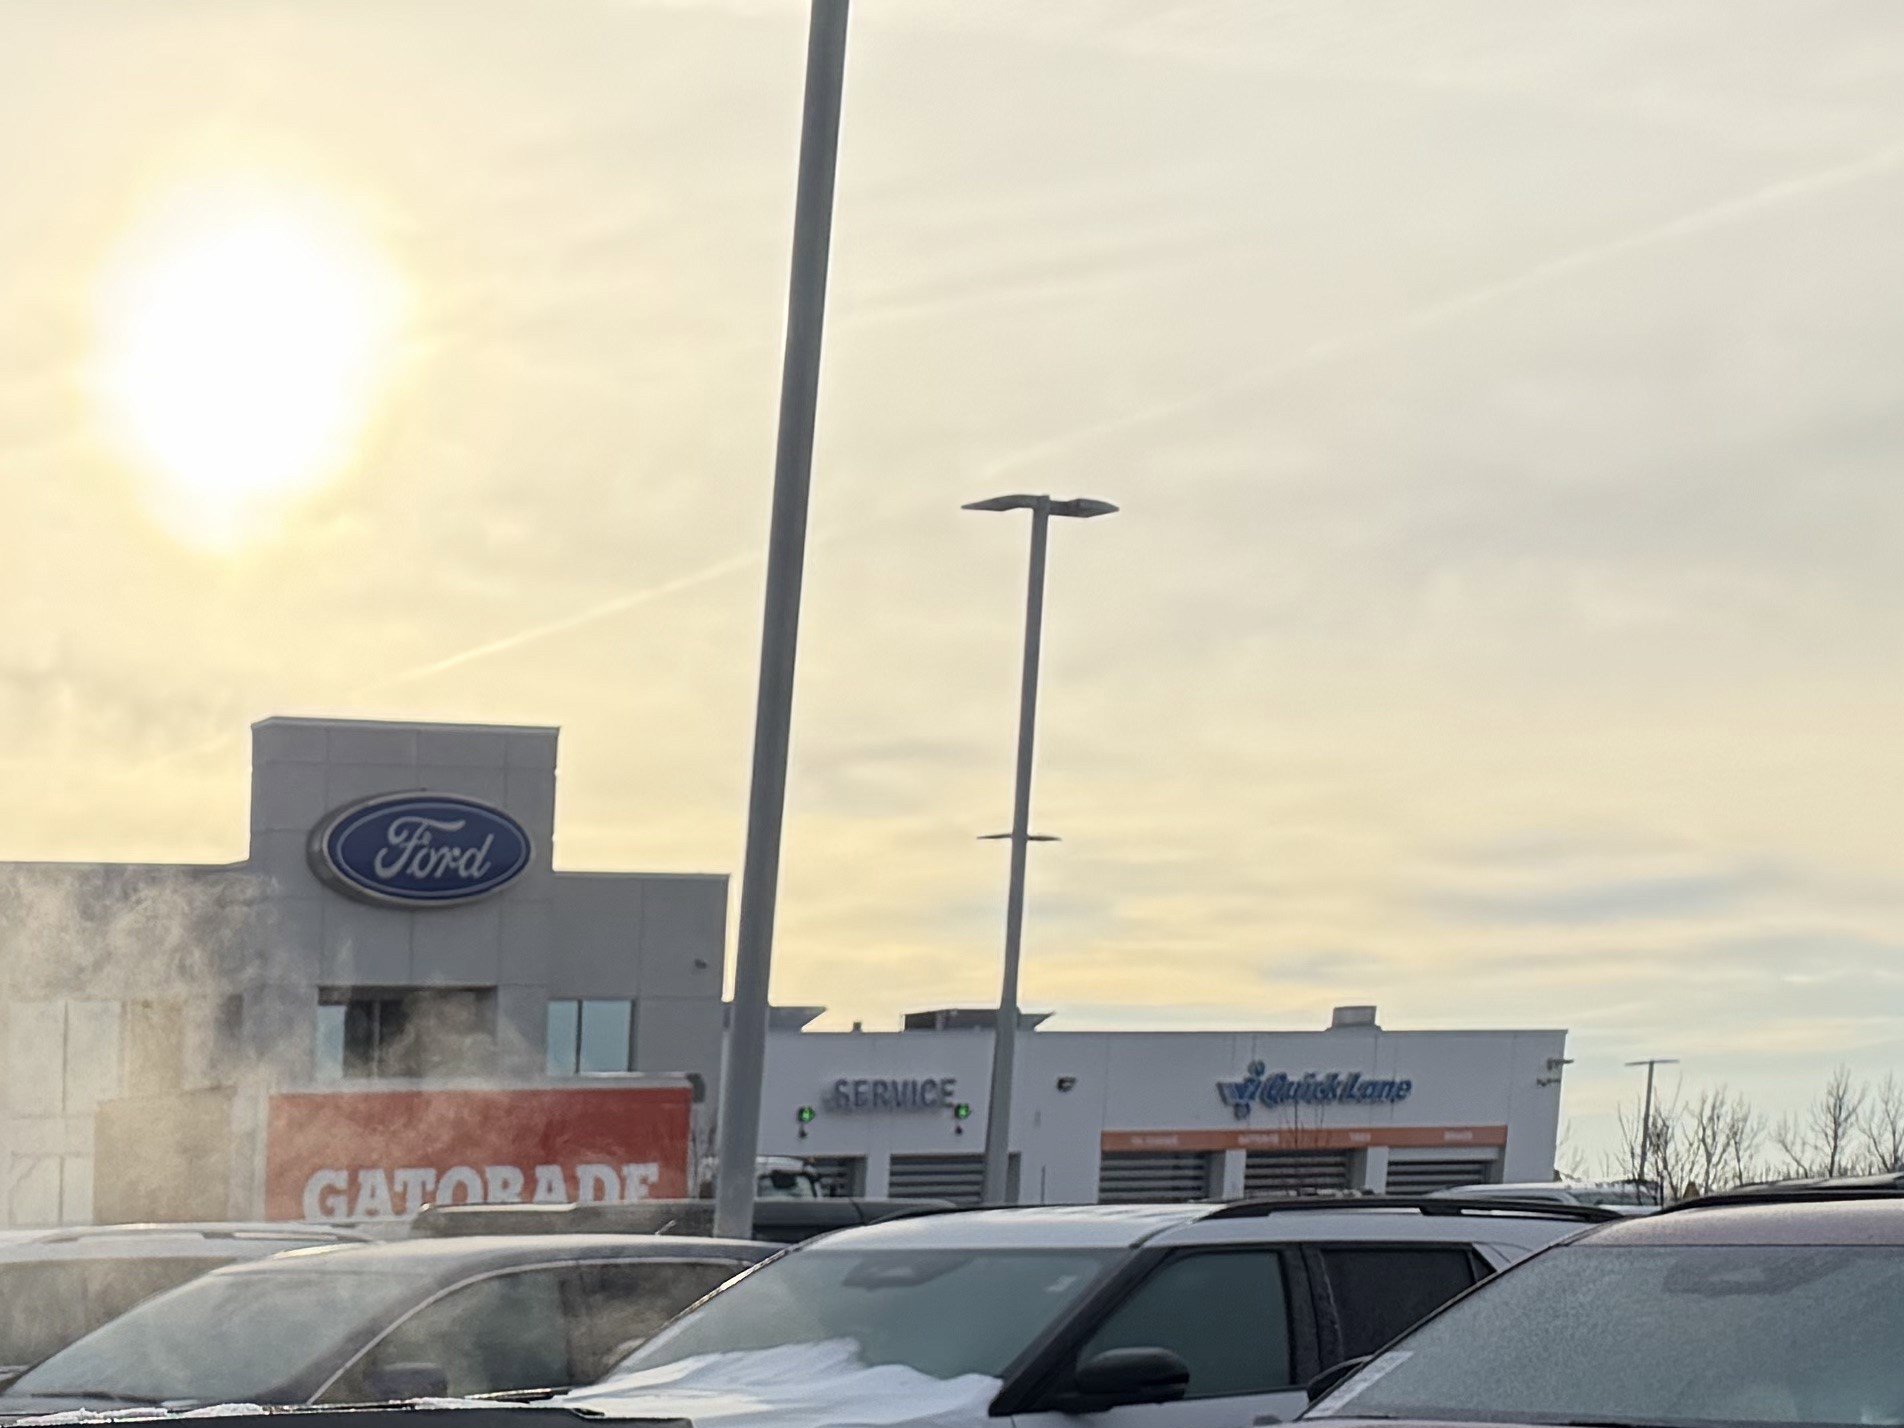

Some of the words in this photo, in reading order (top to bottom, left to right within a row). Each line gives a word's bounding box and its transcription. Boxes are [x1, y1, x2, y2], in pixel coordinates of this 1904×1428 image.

[373, 815, 495, 879] Ford
[833, 1077, 957, 1109] SERVICE
[302, 1162, 660, 1221] GATORADE
